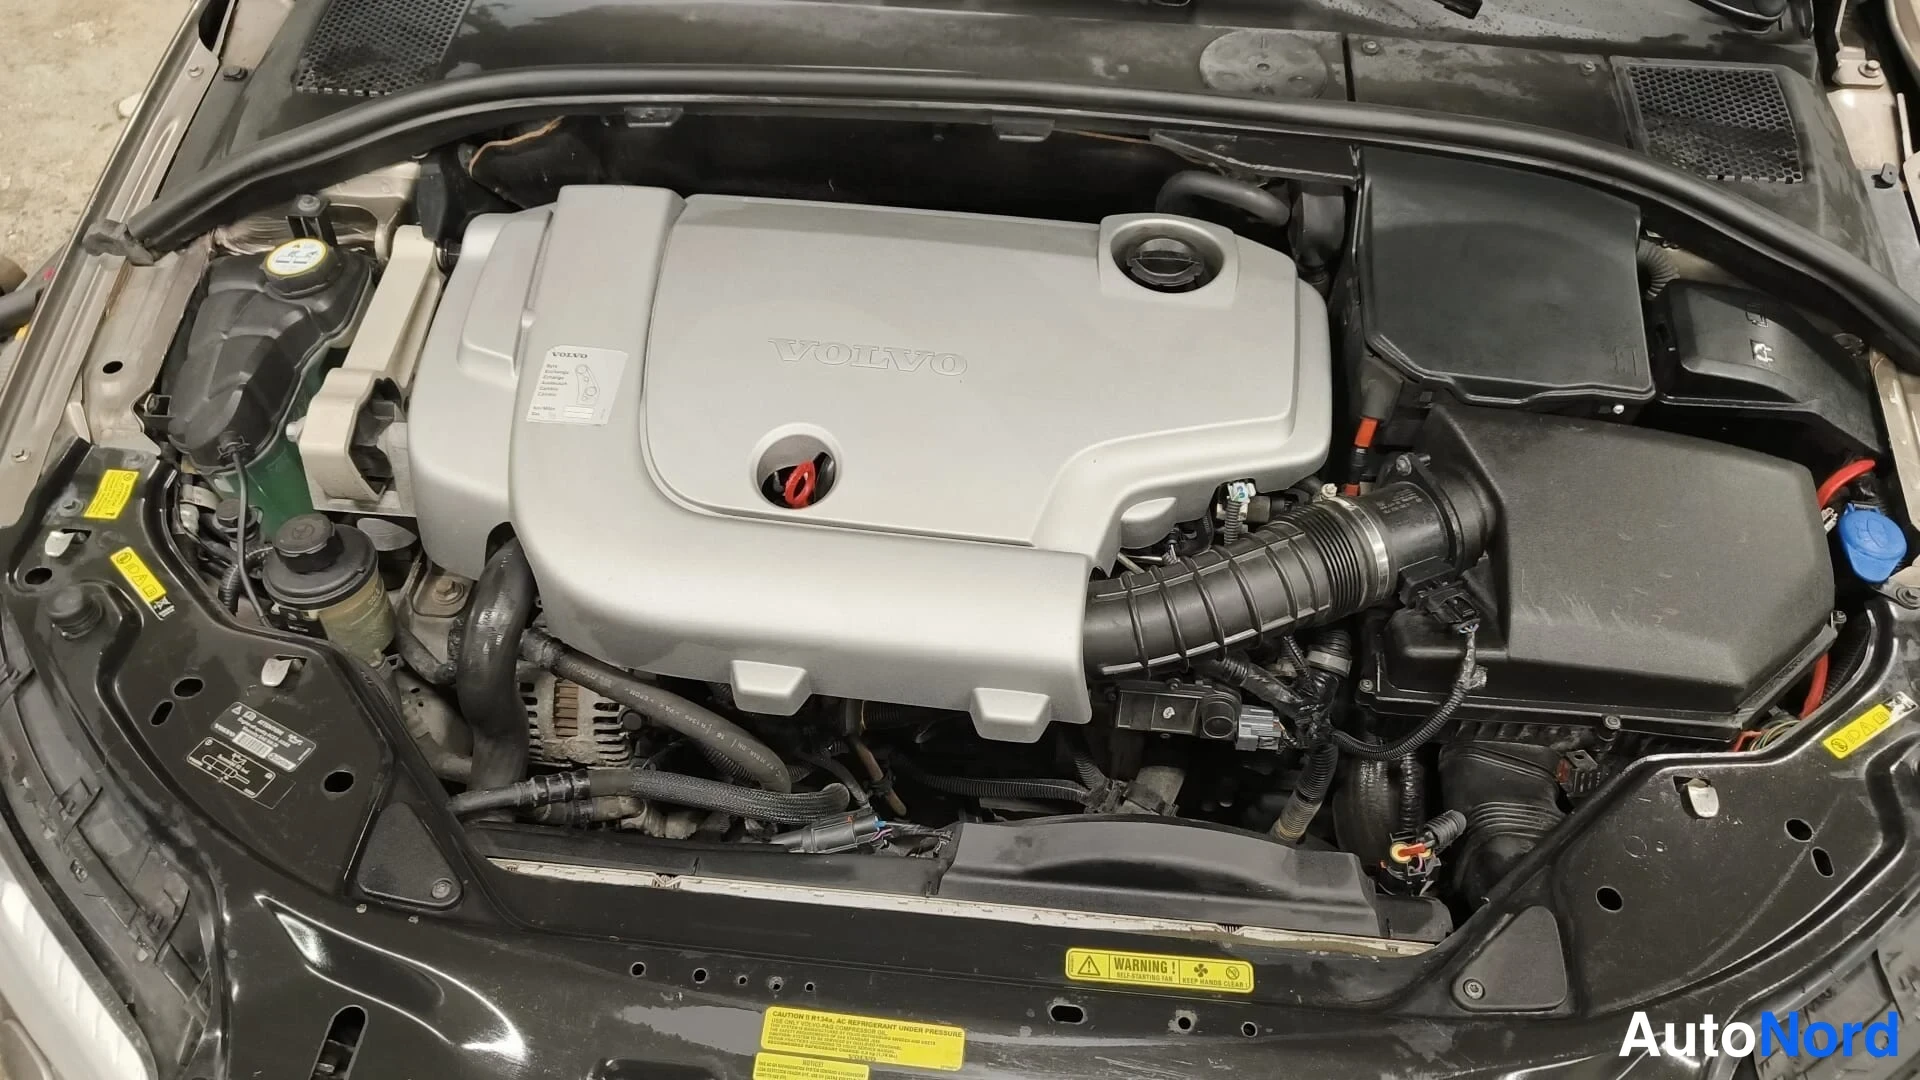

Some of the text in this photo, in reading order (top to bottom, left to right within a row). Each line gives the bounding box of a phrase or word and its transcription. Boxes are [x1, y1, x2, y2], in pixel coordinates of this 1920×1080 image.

[768, 337, 968, 376] VOLVO
[1114, 957, 1175, 974] WARNING !
[1117, 972, 1160, 981] SELF-STARTING
[772, 1011, 804, 1019] CAUTION
[811, 1015, 835, 1023] R134a,
[848, 1019, 897, 1030] REFRIGERANT
[898, 1025, 923, 1033] UNDER
[925, 1028, 962, 1037] PRESSURE
